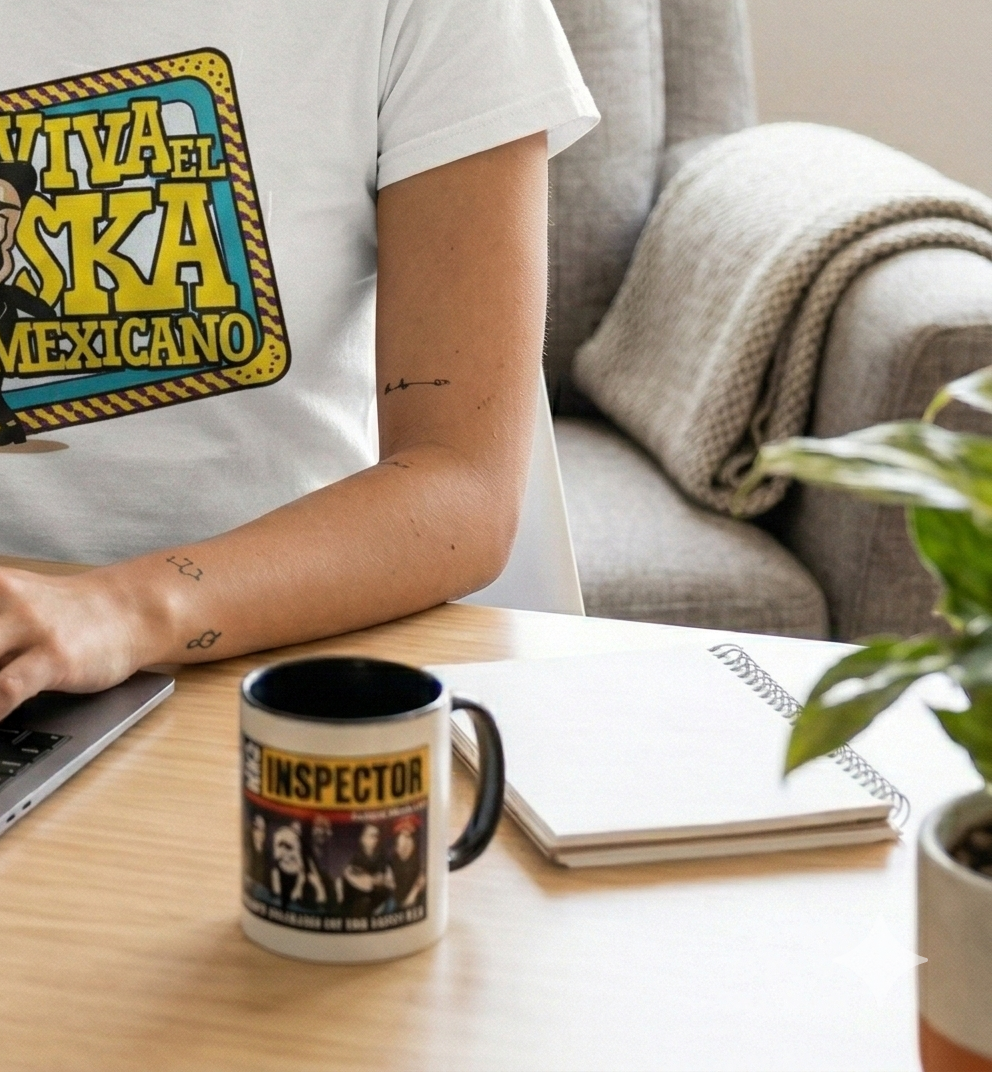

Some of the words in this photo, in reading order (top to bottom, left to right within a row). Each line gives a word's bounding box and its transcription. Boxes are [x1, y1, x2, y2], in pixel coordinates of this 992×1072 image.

[167, 136, 227, 179] EL
[14, 182, 237, 316] SKA
[266, 756, 423, 804] INSPECTOR
